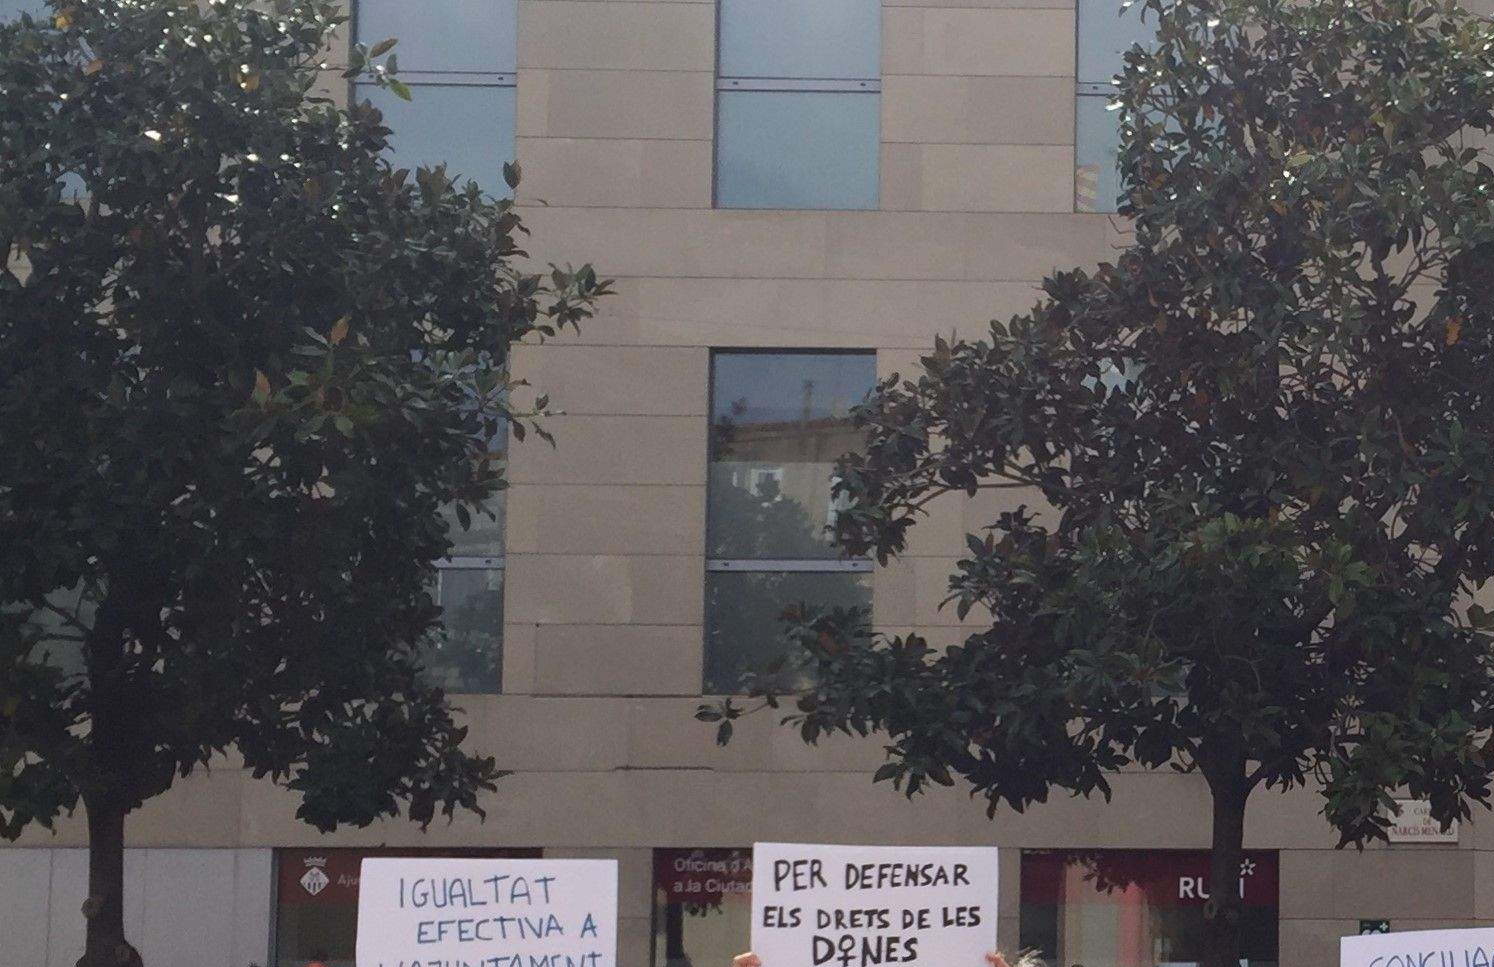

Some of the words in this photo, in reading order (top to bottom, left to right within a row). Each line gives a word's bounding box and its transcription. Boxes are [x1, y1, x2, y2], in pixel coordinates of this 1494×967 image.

[774, 859, 828, 891] PER
[845, 863, 970, 889] DEFENSAR
[400, 875, 556, 908] IGUALTAT
[417, 914, 563, 944] EFECTIVA
[581, 913, 598, 939] A
[763, 906, 802, 928] ELS
[817, 908, 890, 929] DRETS
[902, 908, 931, 930] DE
[943, 906, 981, 927] LES
